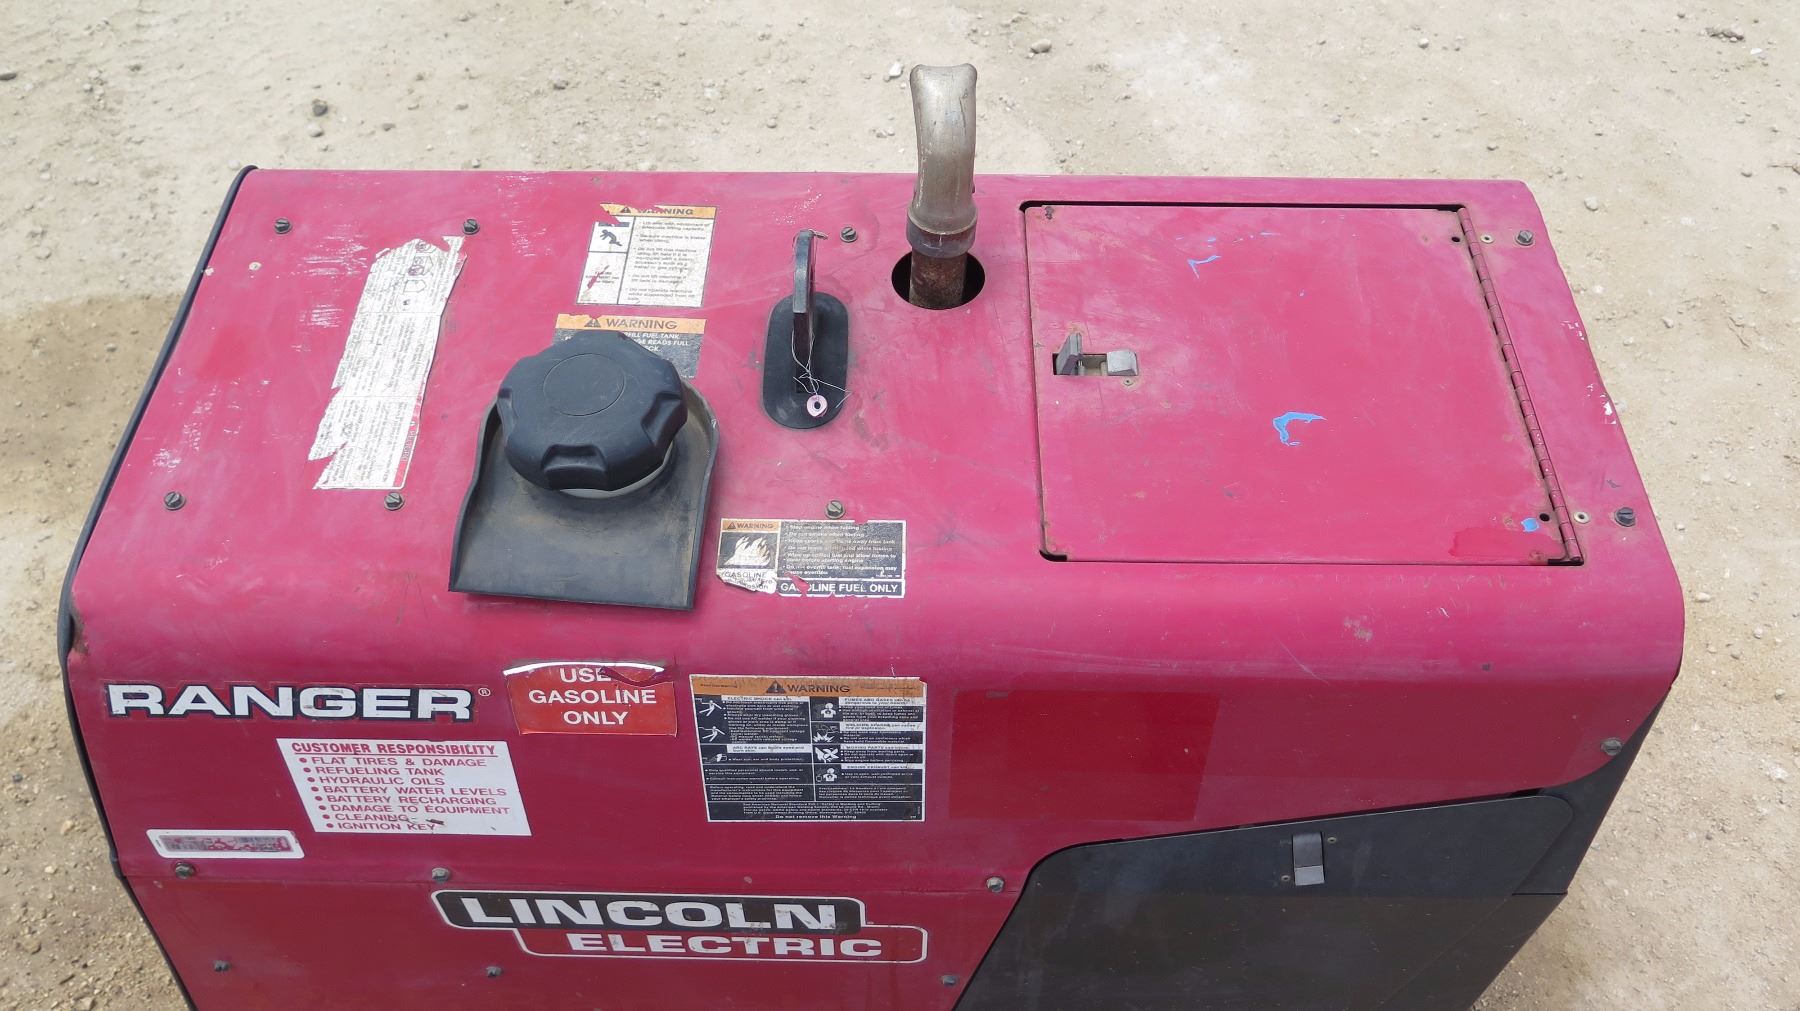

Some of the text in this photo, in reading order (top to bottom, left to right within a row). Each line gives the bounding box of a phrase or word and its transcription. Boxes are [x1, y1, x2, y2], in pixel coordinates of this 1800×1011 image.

[606, 318, 678, 330] WARNING
[780, 583, 898, 593] GALINE FUEL ONLY
[559, 667, 612, 683] USE
[787, 684, 851, 693] WARNING
[107, 684, 472, 720] RANGER
[528, 689, 657, 704] GASOLINE
[563, 710, 629, 725] ONLY
[291, 742, 496, 755] CUSTOMER RESPONSIBILITY
[311, 756, 487, 767] FLAT TIRES & DAMAGE
[315, 766, 445, 776] REFUELING TANK
[318, 776, 446, 786] HYDRAULIC OILS
[323, 785, 507, 796] BATTERY WATER LEVELS
[326, 795, 497, 805] BATTERY RECHARGING
[330, 804, 510, 815] DAMAGE TO EQUIPMENT
[335, 813, 408, 822] CLEANING
[337, 822, 435, 832] IGNITION KEY
[460, 896, 836, 930] LINCOLN
[566, 932, 882, 957] ELECTRIC
